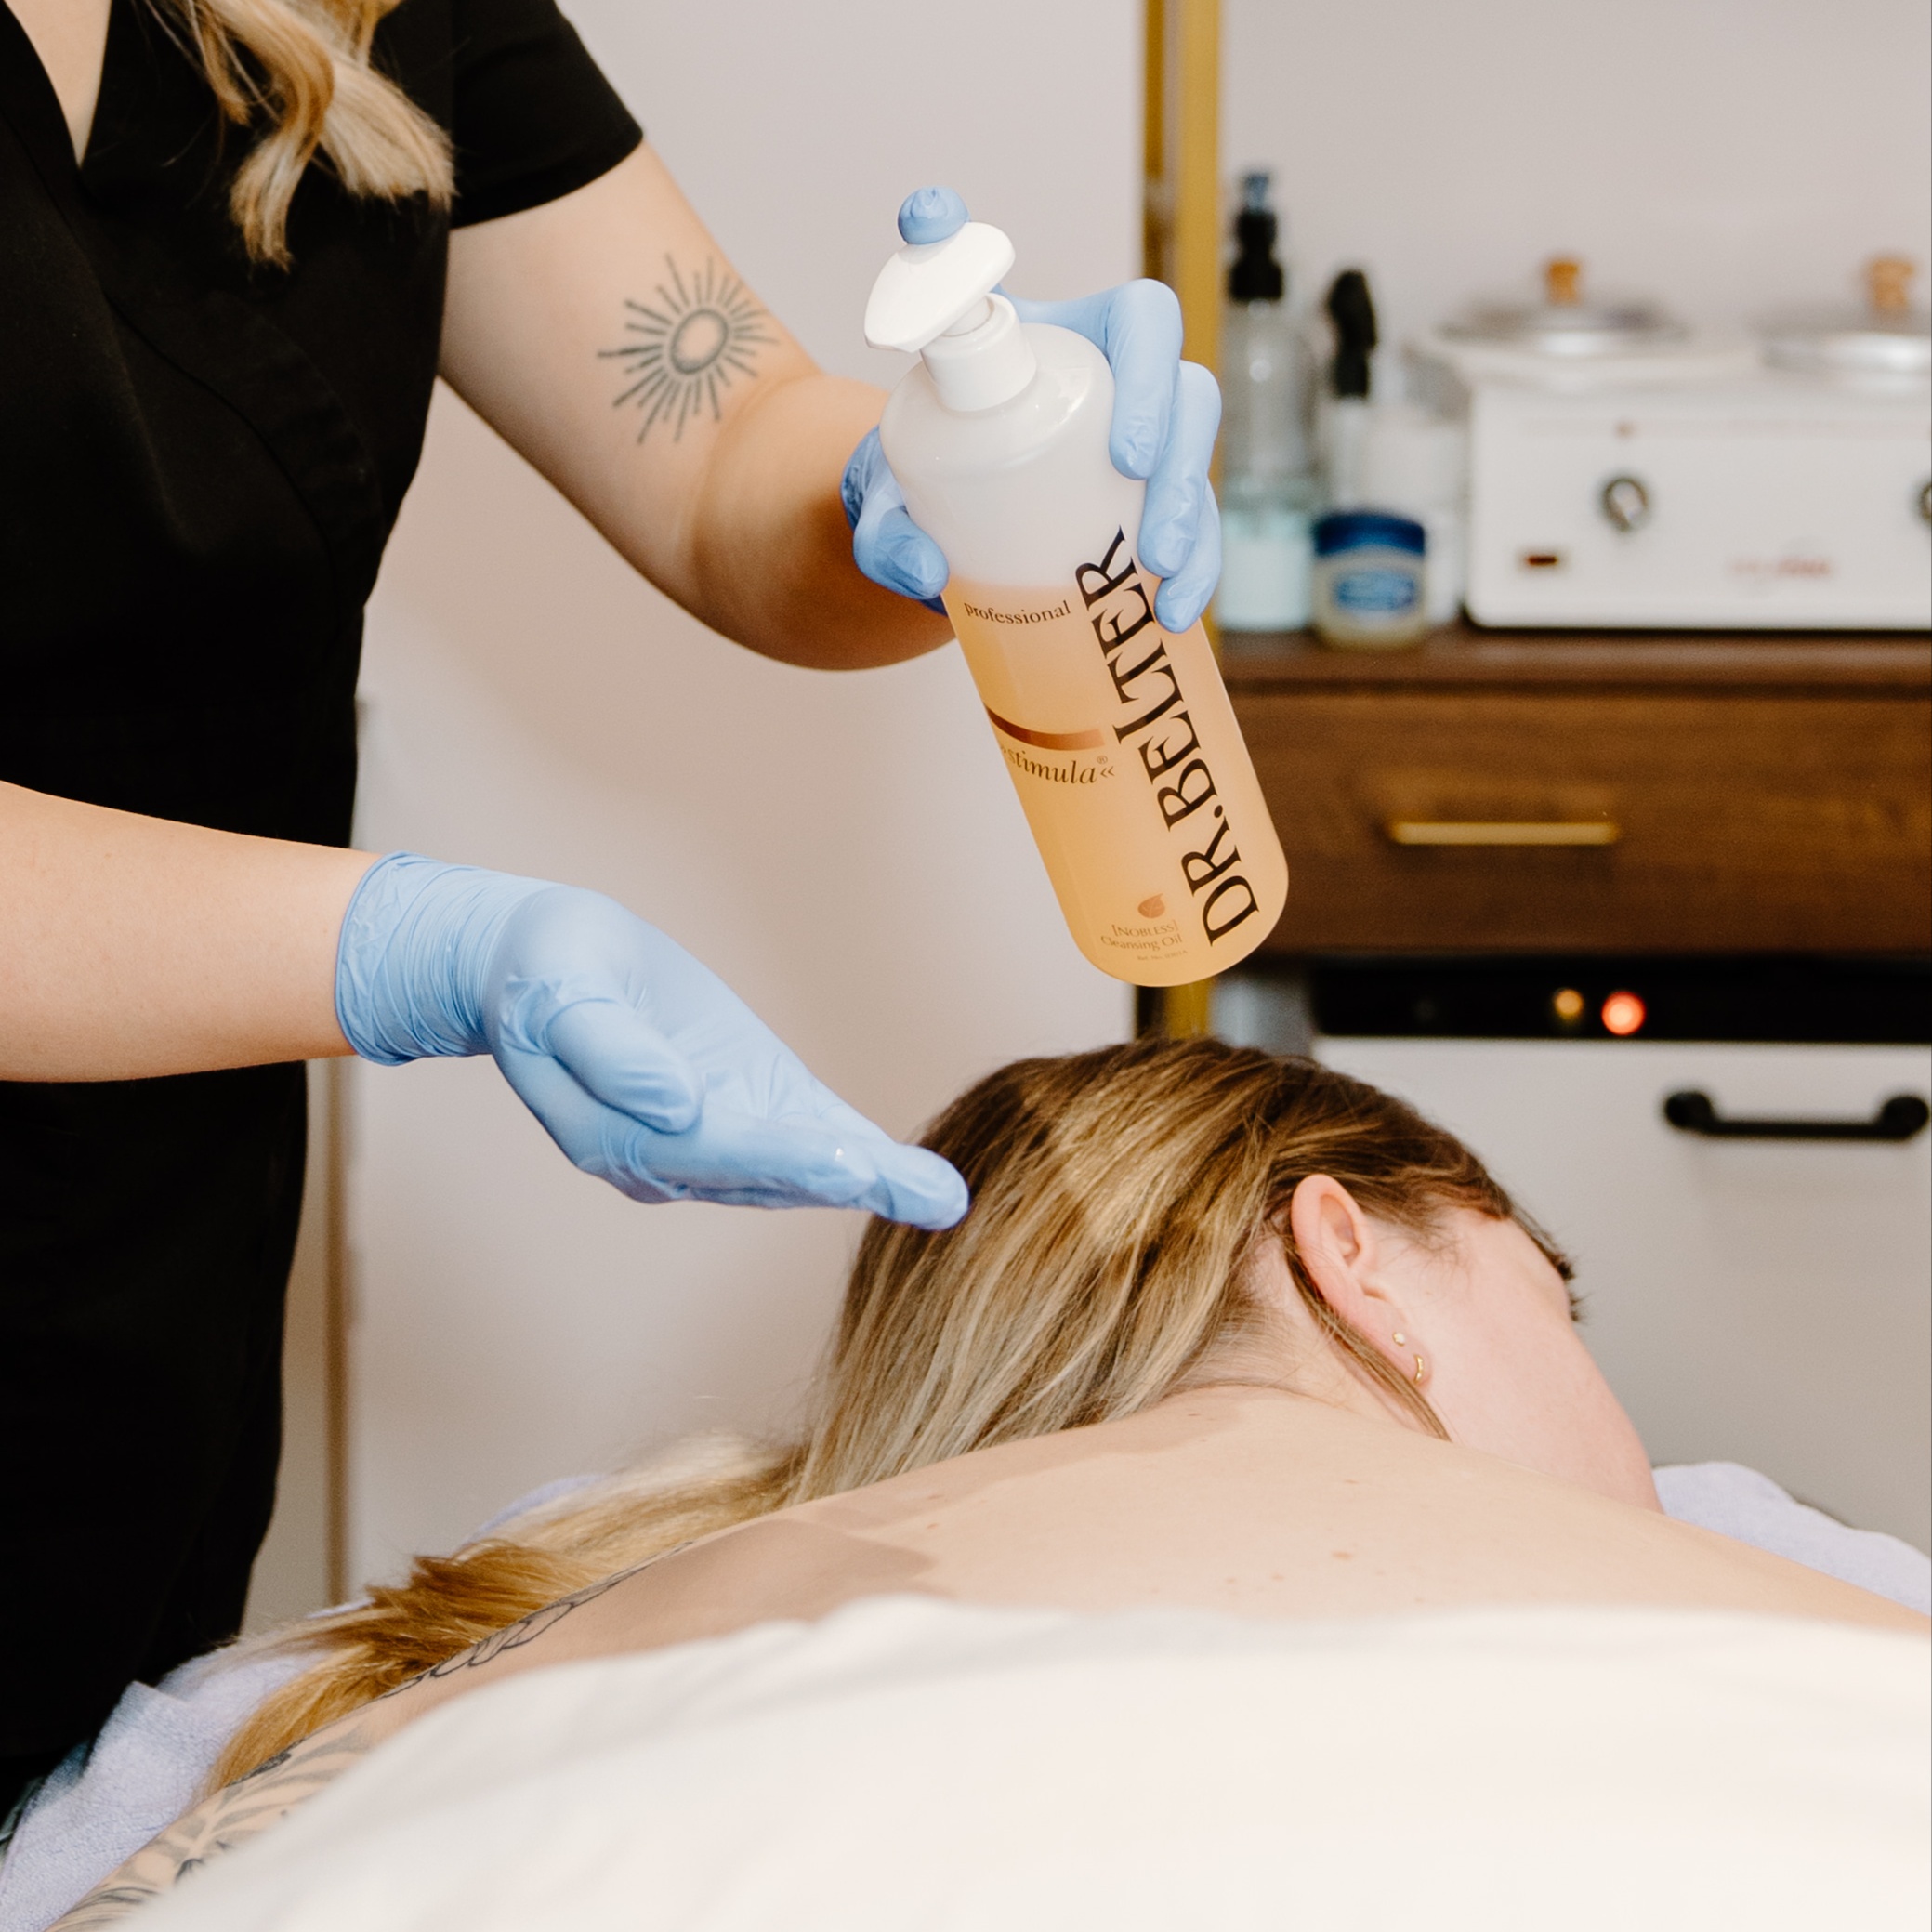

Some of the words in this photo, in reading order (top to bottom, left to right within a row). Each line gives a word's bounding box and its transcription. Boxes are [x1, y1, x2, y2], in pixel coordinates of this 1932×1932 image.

[964, 599, 1071, 624] professional
[1100, 935, 1160, 951] Cleansing
[1161, 933, 1182, 946] Oil
